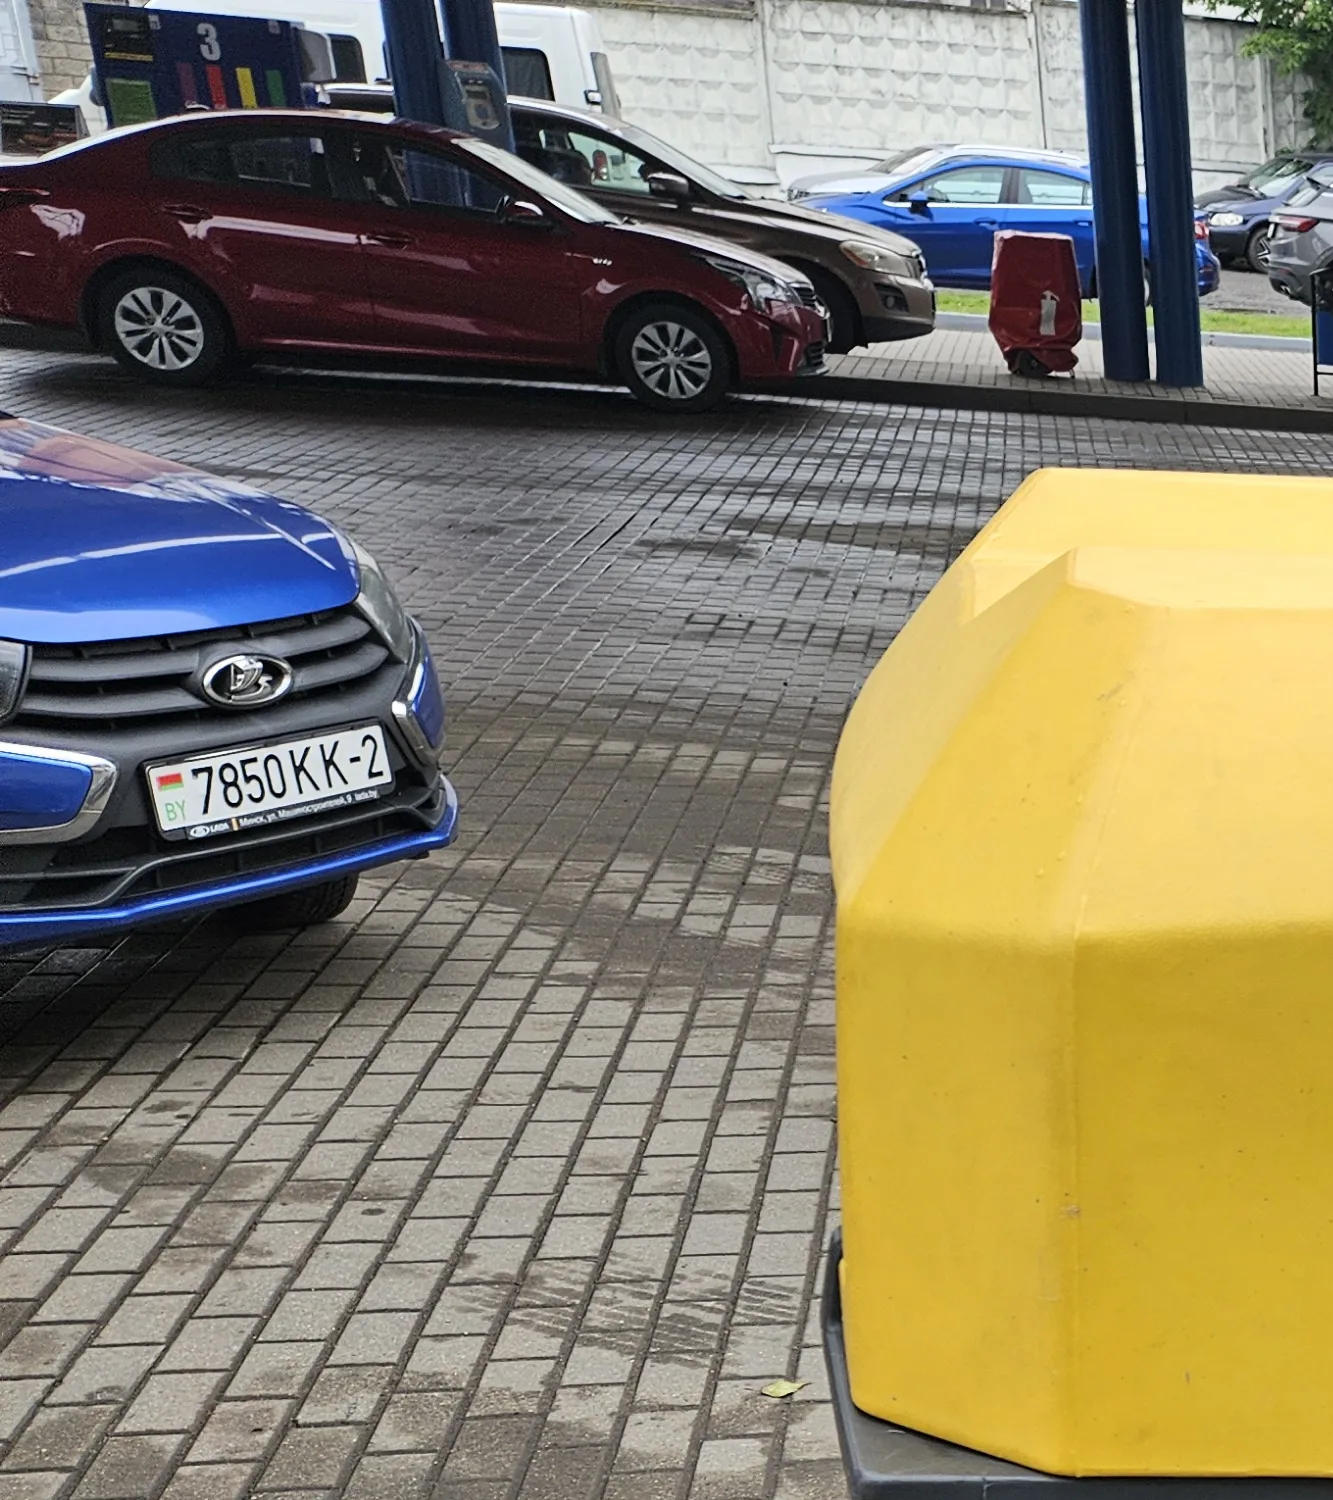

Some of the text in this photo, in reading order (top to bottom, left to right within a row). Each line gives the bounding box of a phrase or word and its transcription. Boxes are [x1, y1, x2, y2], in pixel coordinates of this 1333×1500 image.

[197, 23, 221, 61] 3
[191, 734, 384, 815] 7850KK-2
[165, 800, 187, 823] BY
